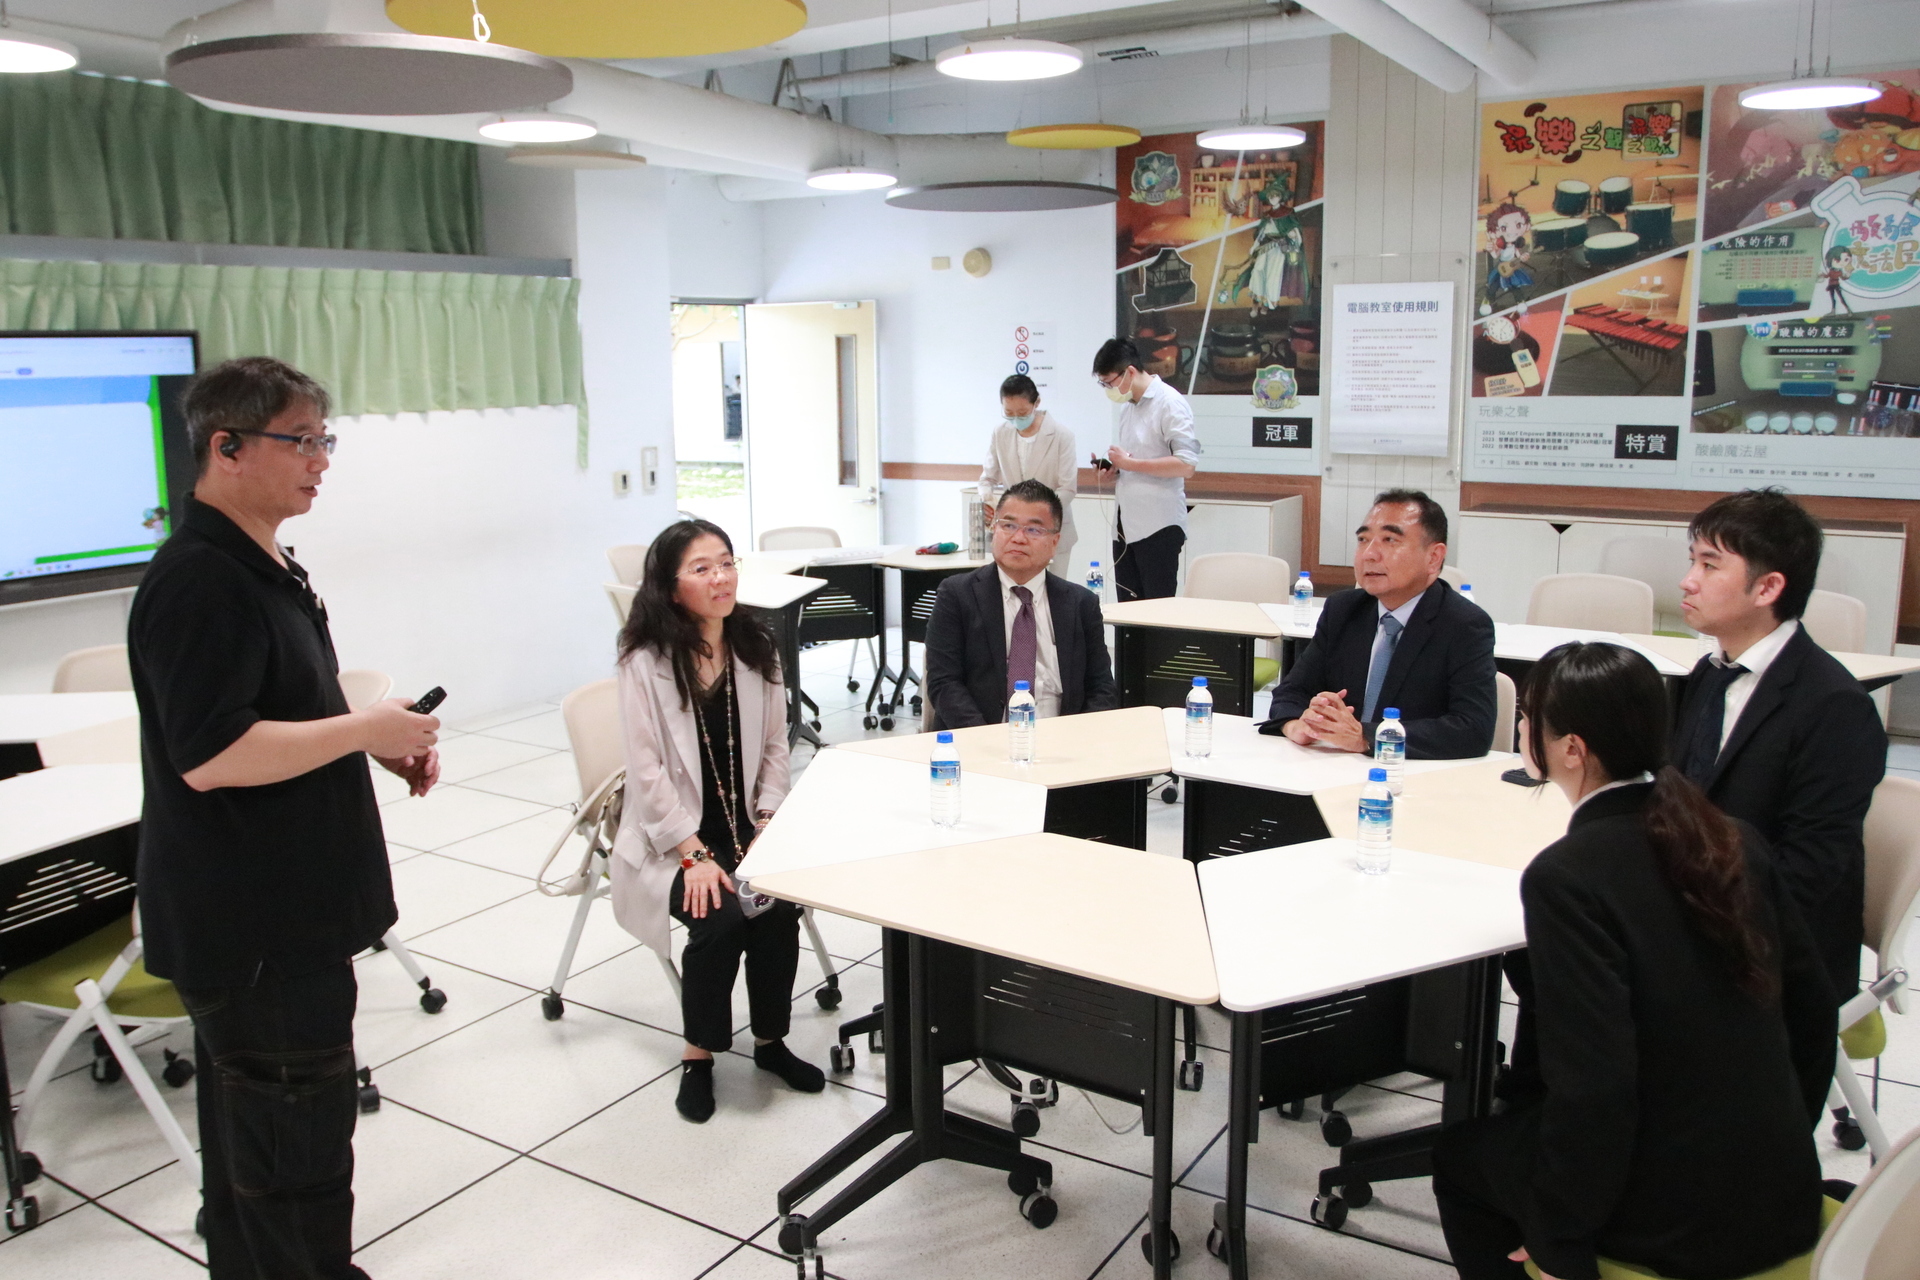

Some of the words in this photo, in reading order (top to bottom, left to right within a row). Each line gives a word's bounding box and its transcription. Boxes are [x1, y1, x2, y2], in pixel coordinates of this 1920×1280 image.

[1347, 300, 1439, 314] 電腦教室使用規則
[1779, 325, 1848, 338] 酸鹼的魔法
[1478, 405, 1530, 418] 玩樂之聲
[1265, 424, 1299, 442] 冠軍
[1625, 433, 1667, 454] 特賞
[1695, 443, 1768, 458] 酸鹼魔法屋
